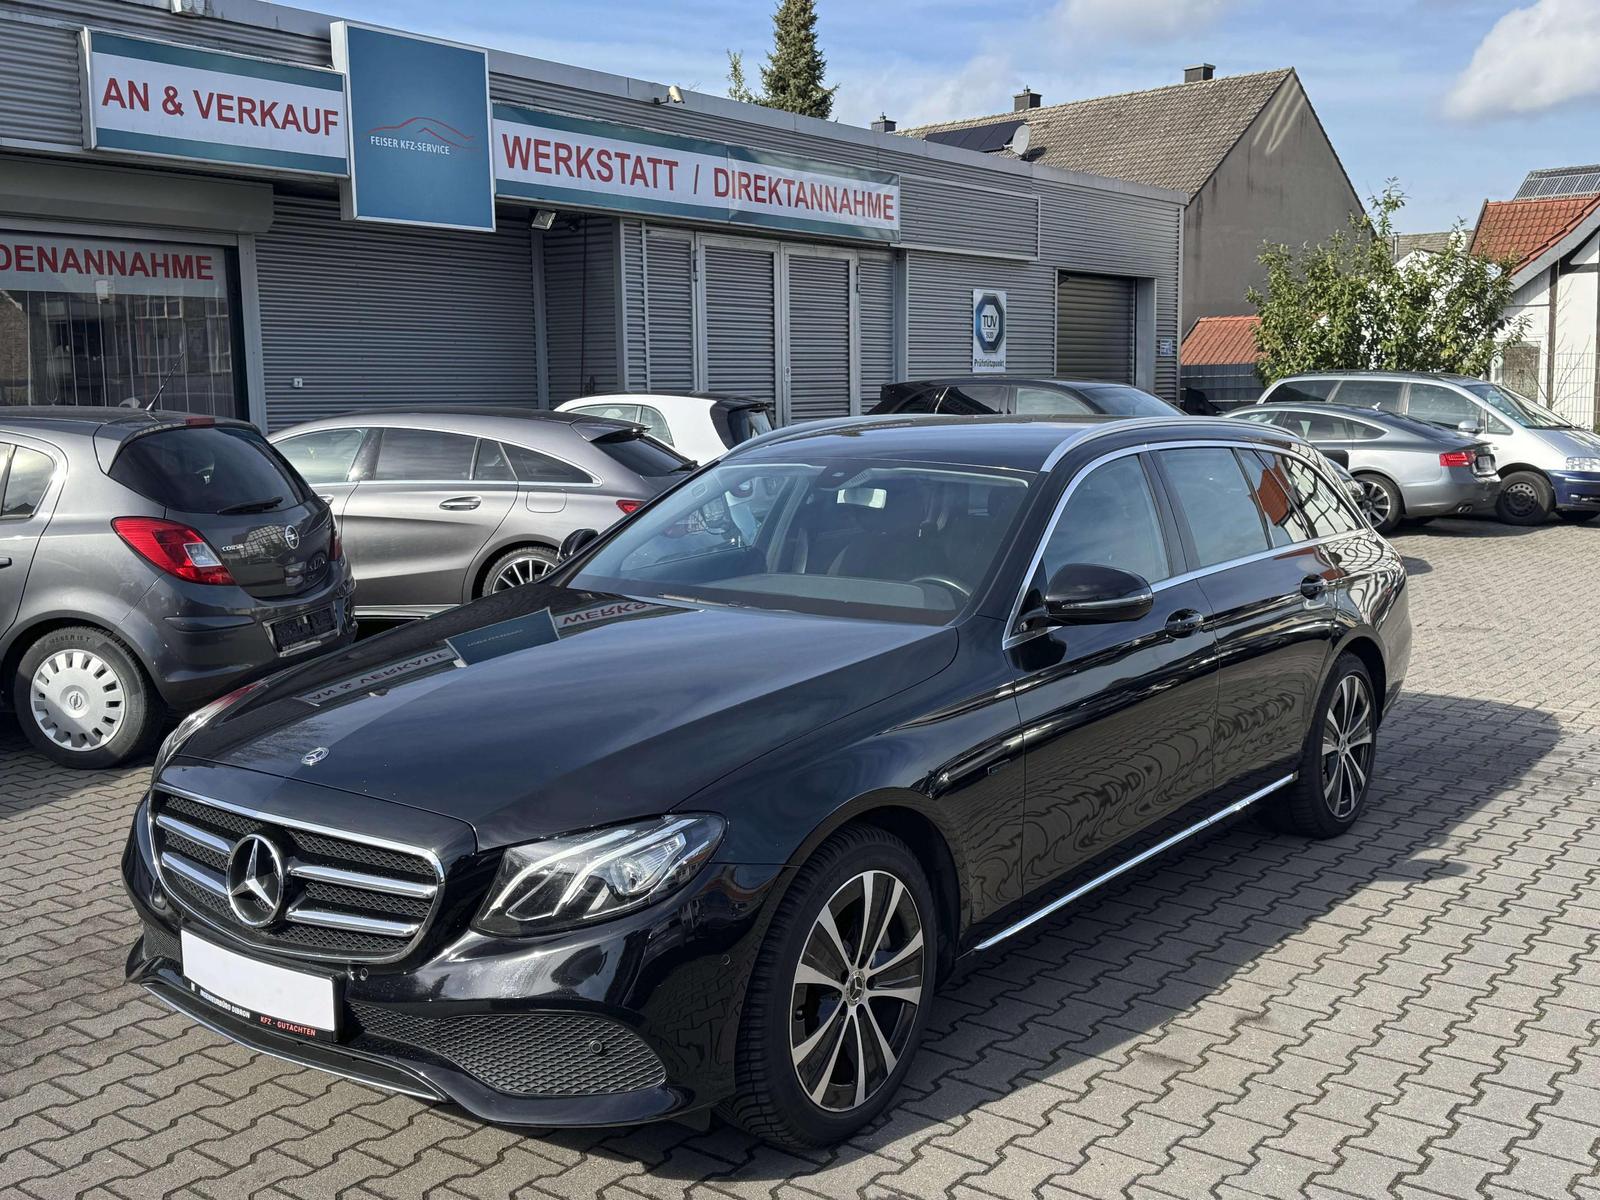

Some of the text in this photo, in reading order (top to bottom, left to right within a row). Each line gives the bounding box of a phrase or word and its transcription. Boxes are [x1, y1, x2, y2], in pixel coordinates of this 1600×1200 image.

[101, 78, 339, 137] AN & VERKAUF
[370, 135, 450, 155] FEISER KFZ-SERVICE
[502, 133, 895, 222] WERKSTATT / DIREKTANNAHME
[982, 315, 998, 328] TÜV
[260, 1016, 272, 1026] KFZ
[277, 1021, 316, 1037] GUTACHTEN
